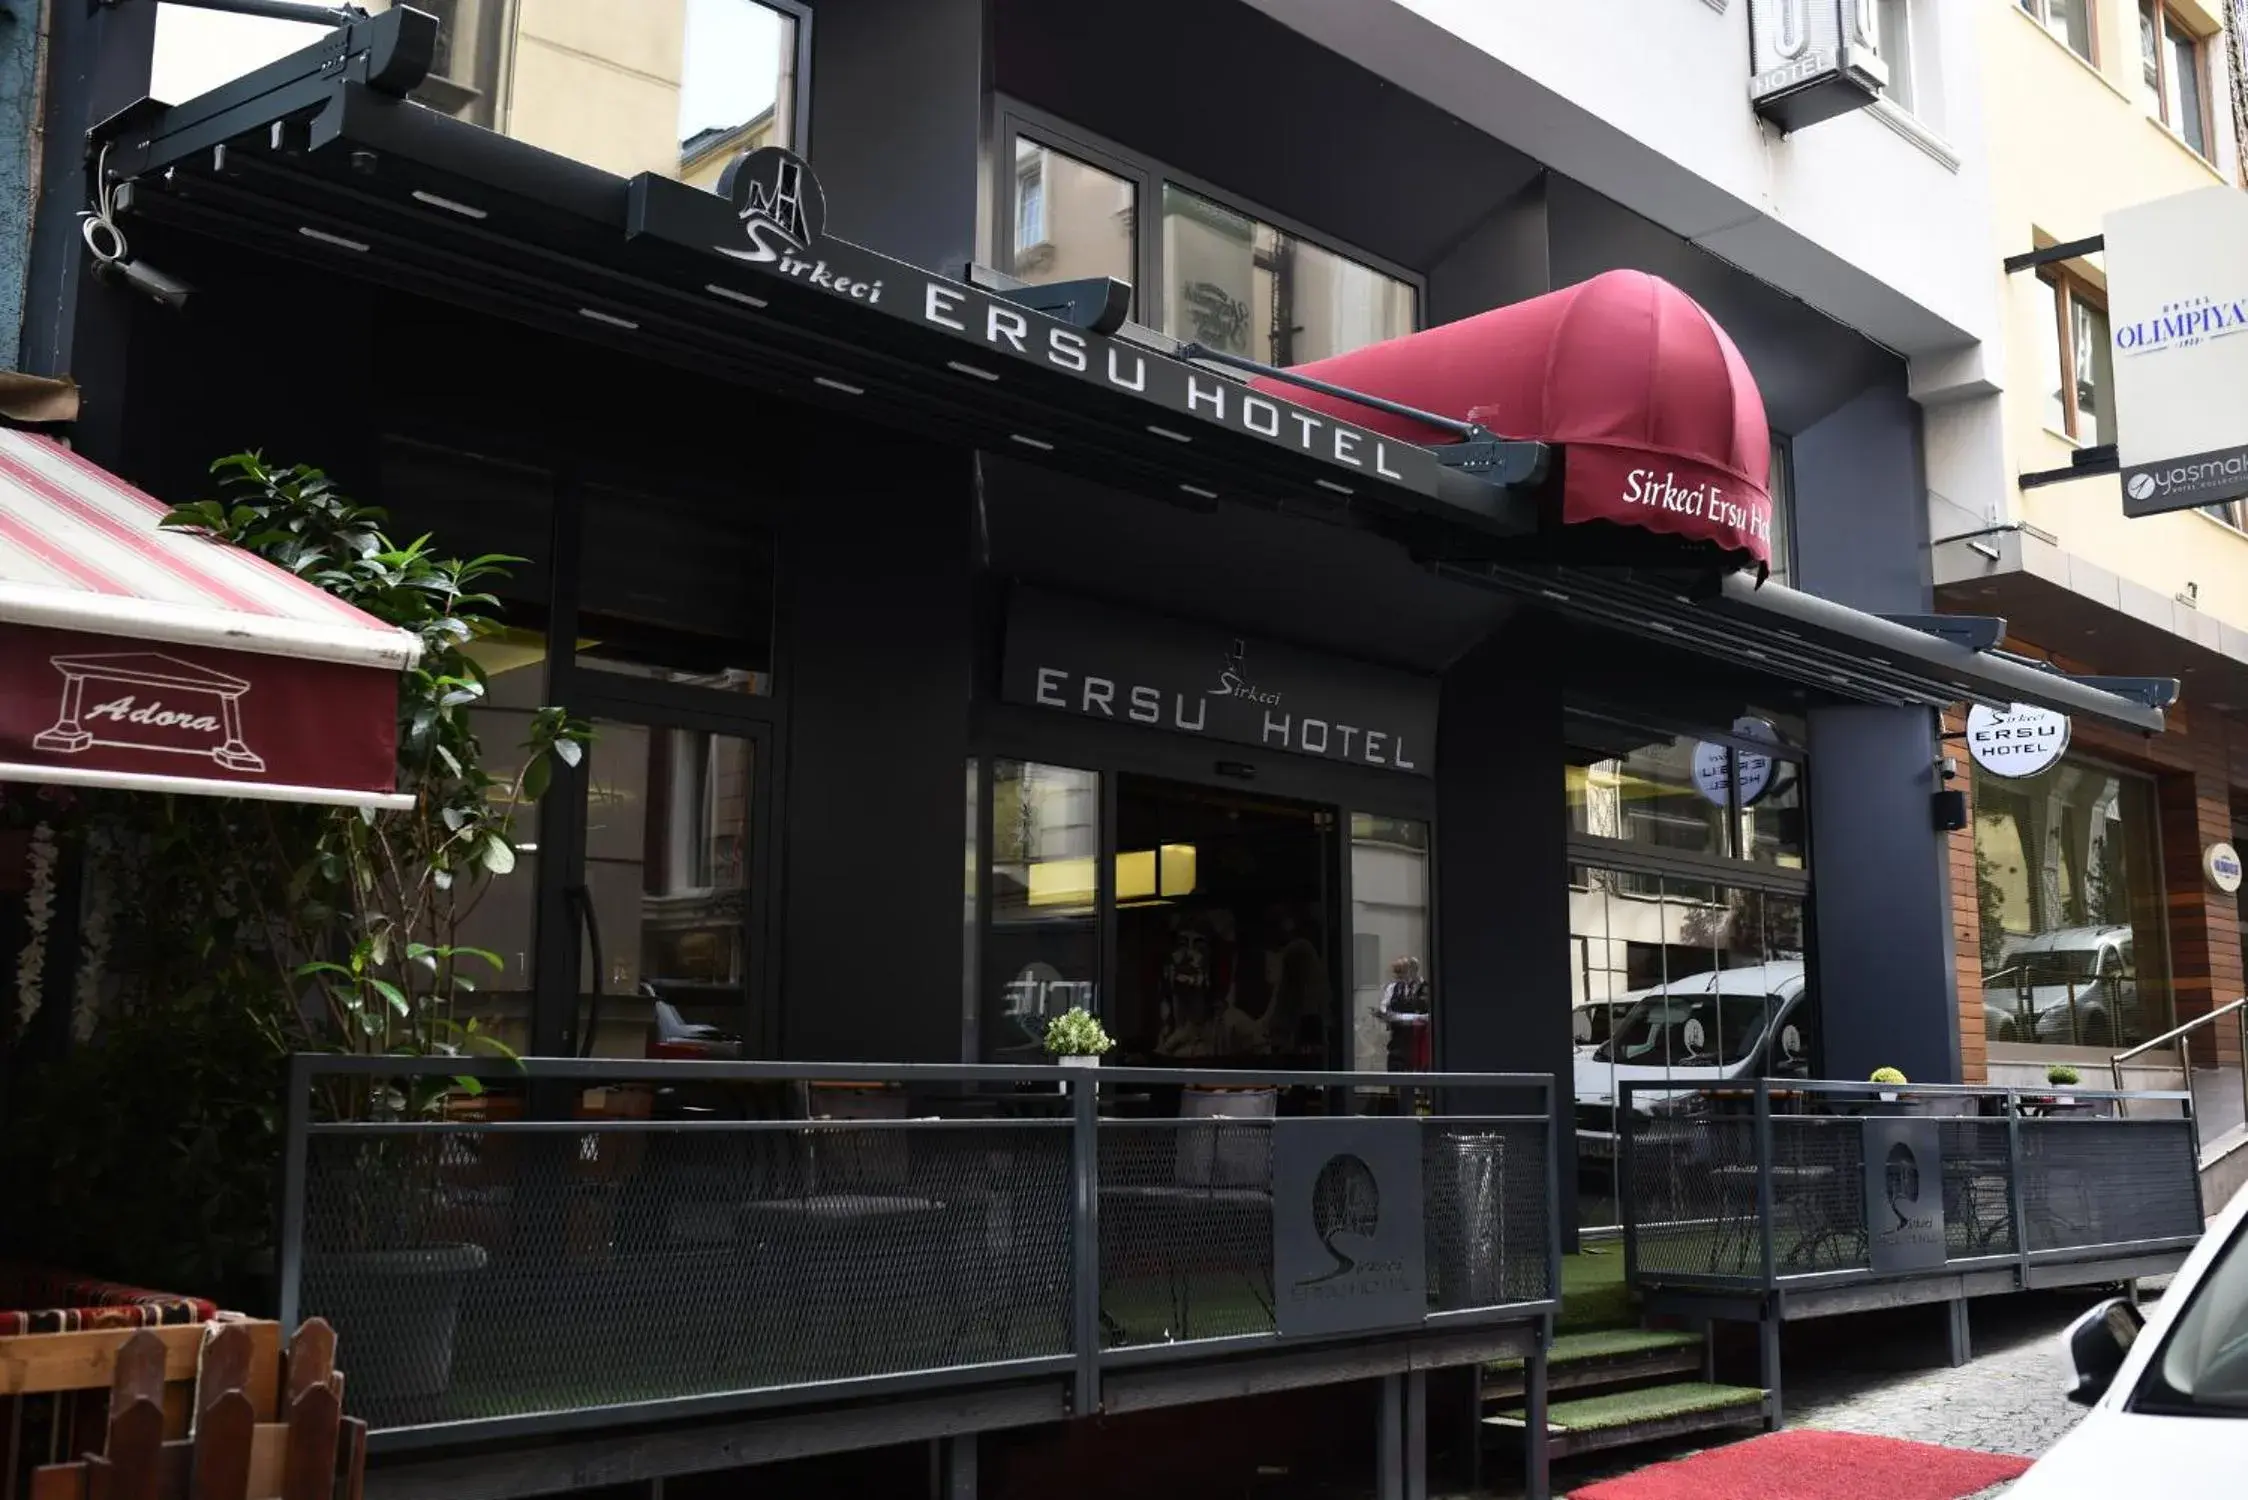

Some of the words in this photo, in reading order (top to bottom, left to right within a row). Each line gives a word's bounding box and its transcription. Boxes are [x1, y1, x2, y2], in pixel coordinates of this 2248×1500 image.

[1756, 54, 1828, 92] HOTEL
[712, 217, 884, 304] Sirkeci
[926, 282, 1145, 392] ERSU
[1187, 375, 1403, 480] HOTEL
[1622, 468, 1705, 517] Sirkeci
[1708, 486, 1747, 531] Ersu
[1206, 671, 1282, 707] Sirkeci
[84, 695, 221, 733] Adora
[1037, 666, 1206, 731] ERSU
[1262, 709, 1414, 769] HOTEL
[1975, 726, 2056, 742] ERSU
[1982, 743, 2048, 756] HOTEL
